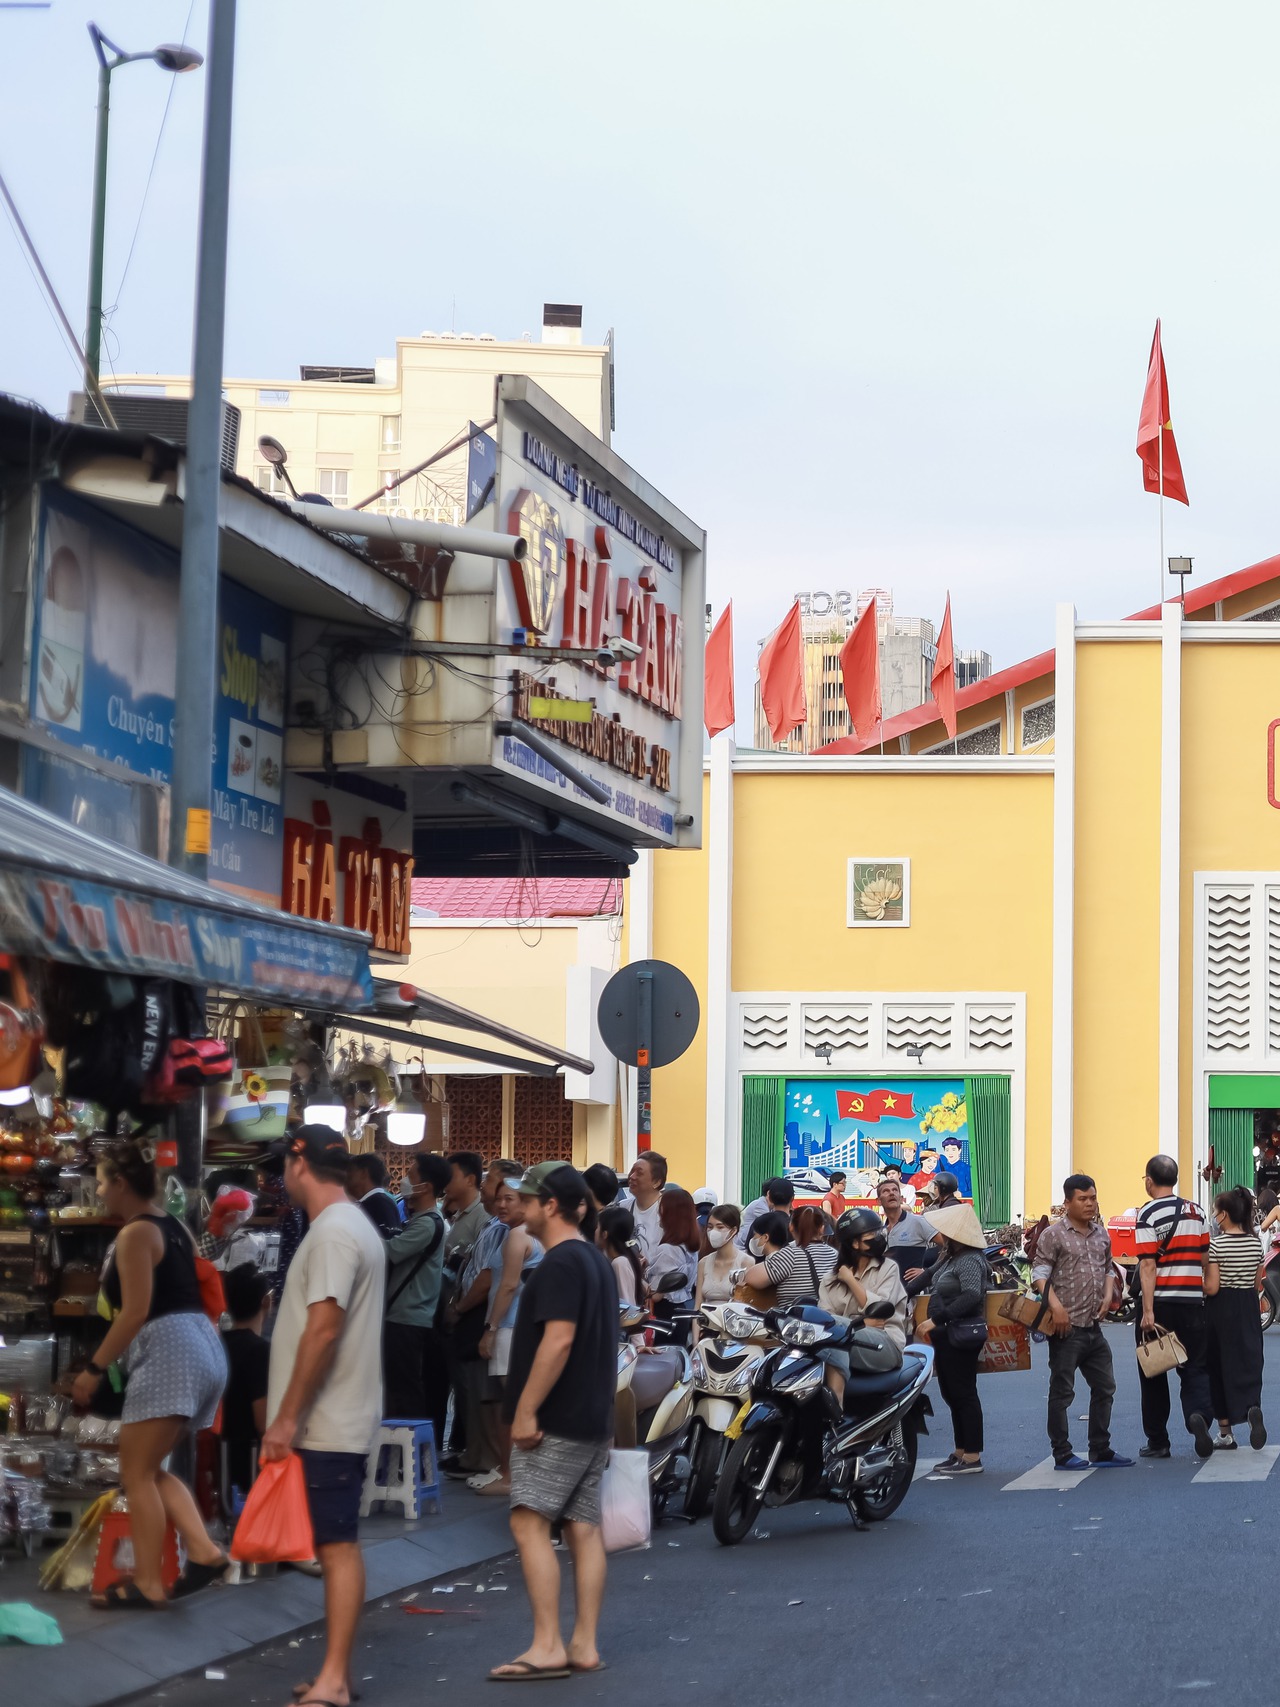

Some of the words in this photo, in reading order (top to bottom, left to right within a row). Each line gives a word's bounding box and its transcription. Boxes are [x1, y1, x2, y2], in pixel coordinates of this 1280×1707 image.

[524, 432, 555, 479] DOANH
[554, 455, 583, 502] NGHIỆP
[595, 490, 617, 527] NHÂN
[616, 505, 635, 545] KINH
[634, 519, 659, 560] DOANH
[221, 624, 257, 721] Shop
[108, 695, 164, 744] Chuyên
[212, 788, 237, 830] Mây
[240, 797, 259, 830] Tre
[260, 805, 275, 835] Lá
[196, 915, 243, 981] Shop
[145, 995, 159, 1037] NEW
[141, 1041, 157, 1071] ERA
